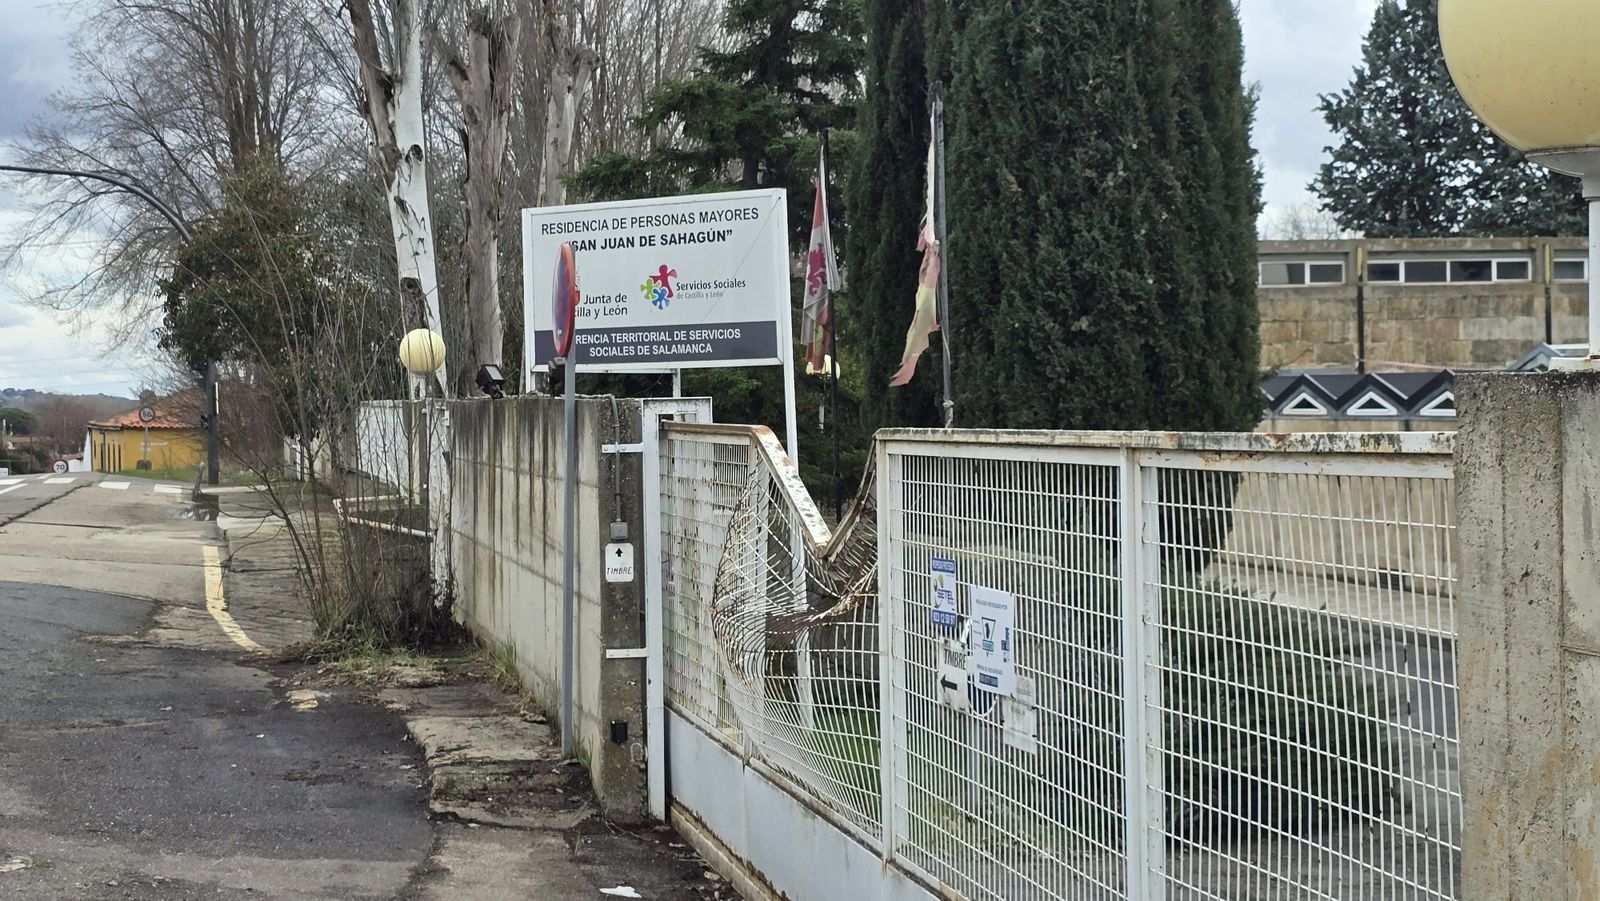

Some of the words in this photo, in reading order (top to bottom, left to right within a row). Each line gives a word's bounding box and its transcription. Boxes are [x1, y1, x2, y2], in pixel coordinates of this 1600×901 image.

[541, 219, 609, 235] RESIDENCIA
[612, 217, 627, 229] DE
[631, 213, 695, 228] PERSONAS
[699, 207, 759, 223] MAYORES
[601, 237, 635, 250] JUAN
[639, 235, 655, 247] DE
[677, 281, 711, 291] Servicios
[714, 278, 746, 289] Sociales
[584, 294, 613, 304] Junta
[616, 293, 627, 303] de
[594, 308, 600, 319] y
[603, 306, 628, 316] León
[576, 332, 609, 344] RENCIA
[611, 330, 672, 343] TERRITORIAL
[674, 329, 686, 340] DE
[689, 328, 741, 339] SERVICIOS
[590, 346, 634, 357] SOCIALES
[637, 345, 650, 356] DE
[653, 343, 712, 355] SALAMANCA
